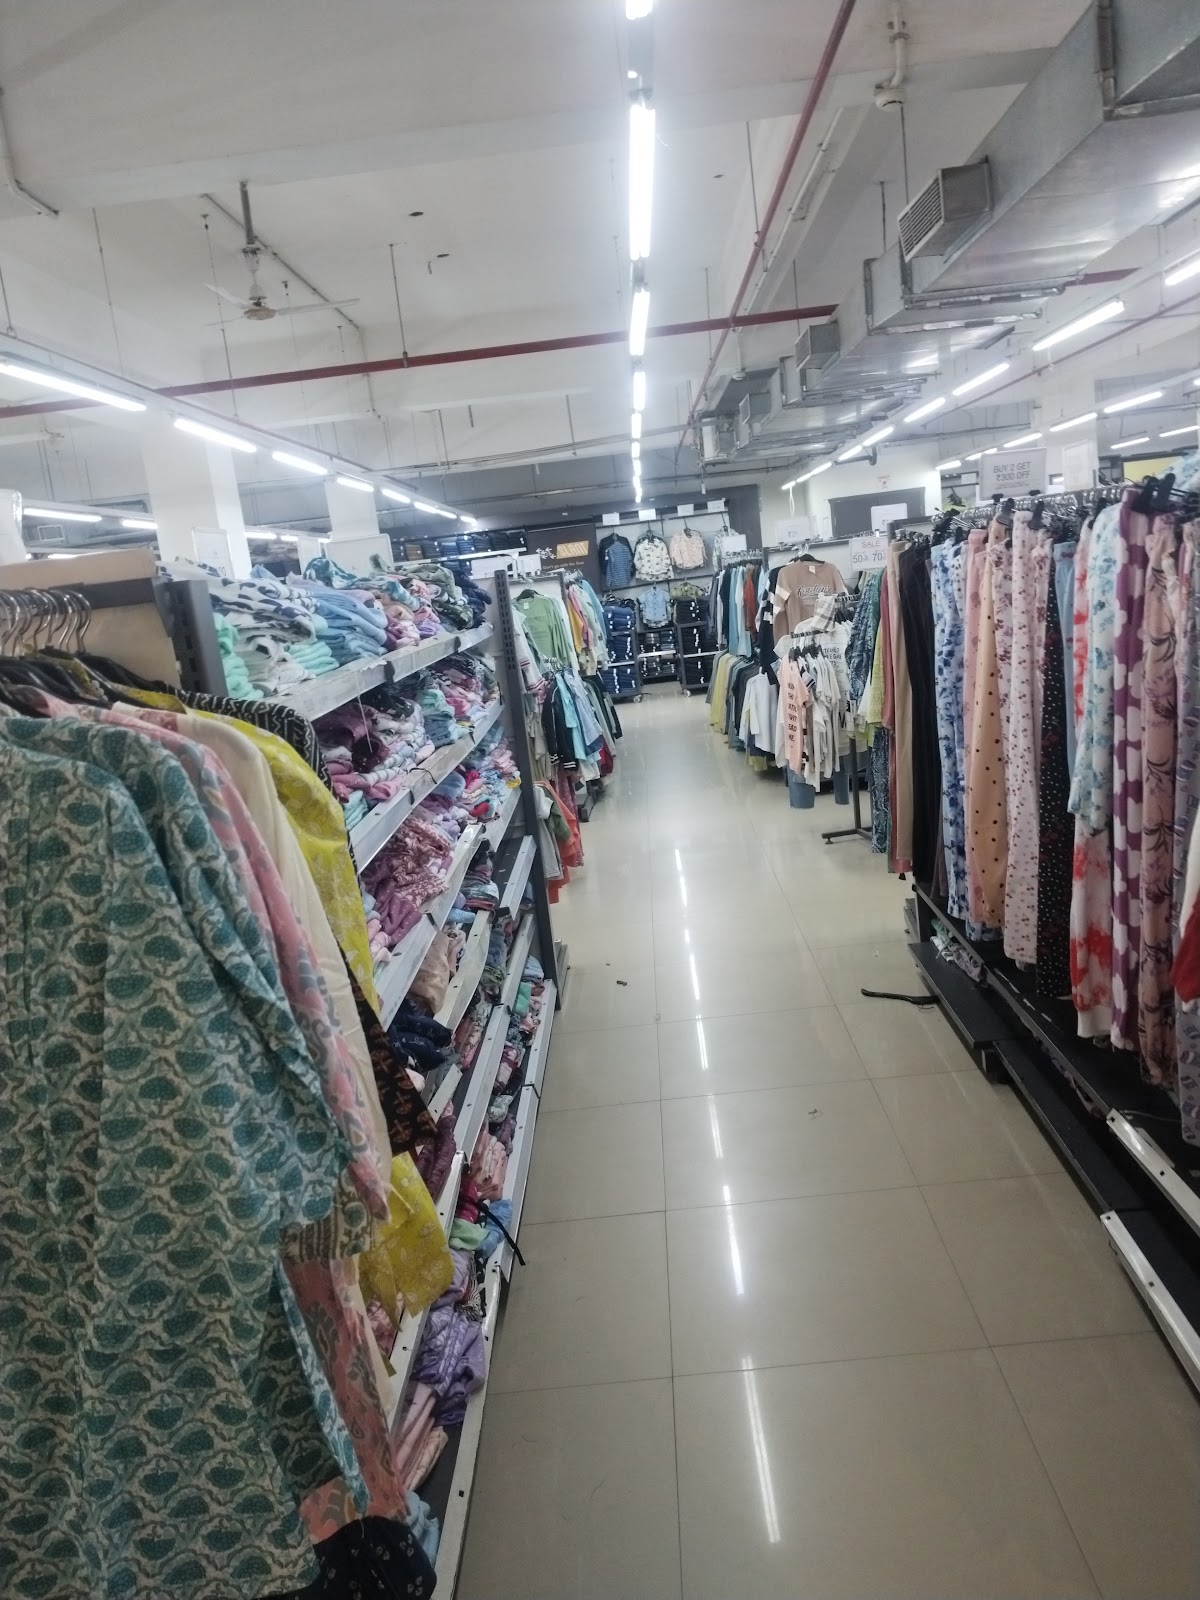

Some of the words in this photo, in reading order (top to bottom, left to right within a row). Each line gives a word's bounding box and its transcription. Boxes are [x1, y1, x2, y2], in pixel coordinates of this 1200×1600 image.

[994, 465, 1008, 473] BUY
[1017, 462, 1031, 470] GET
[996, 472, 1015, 481] ₹300
[1017, 471, 1030, 479] OFF
[861, 540, 881, 548] SALE
[558, 542, 588, 558] SLANT
